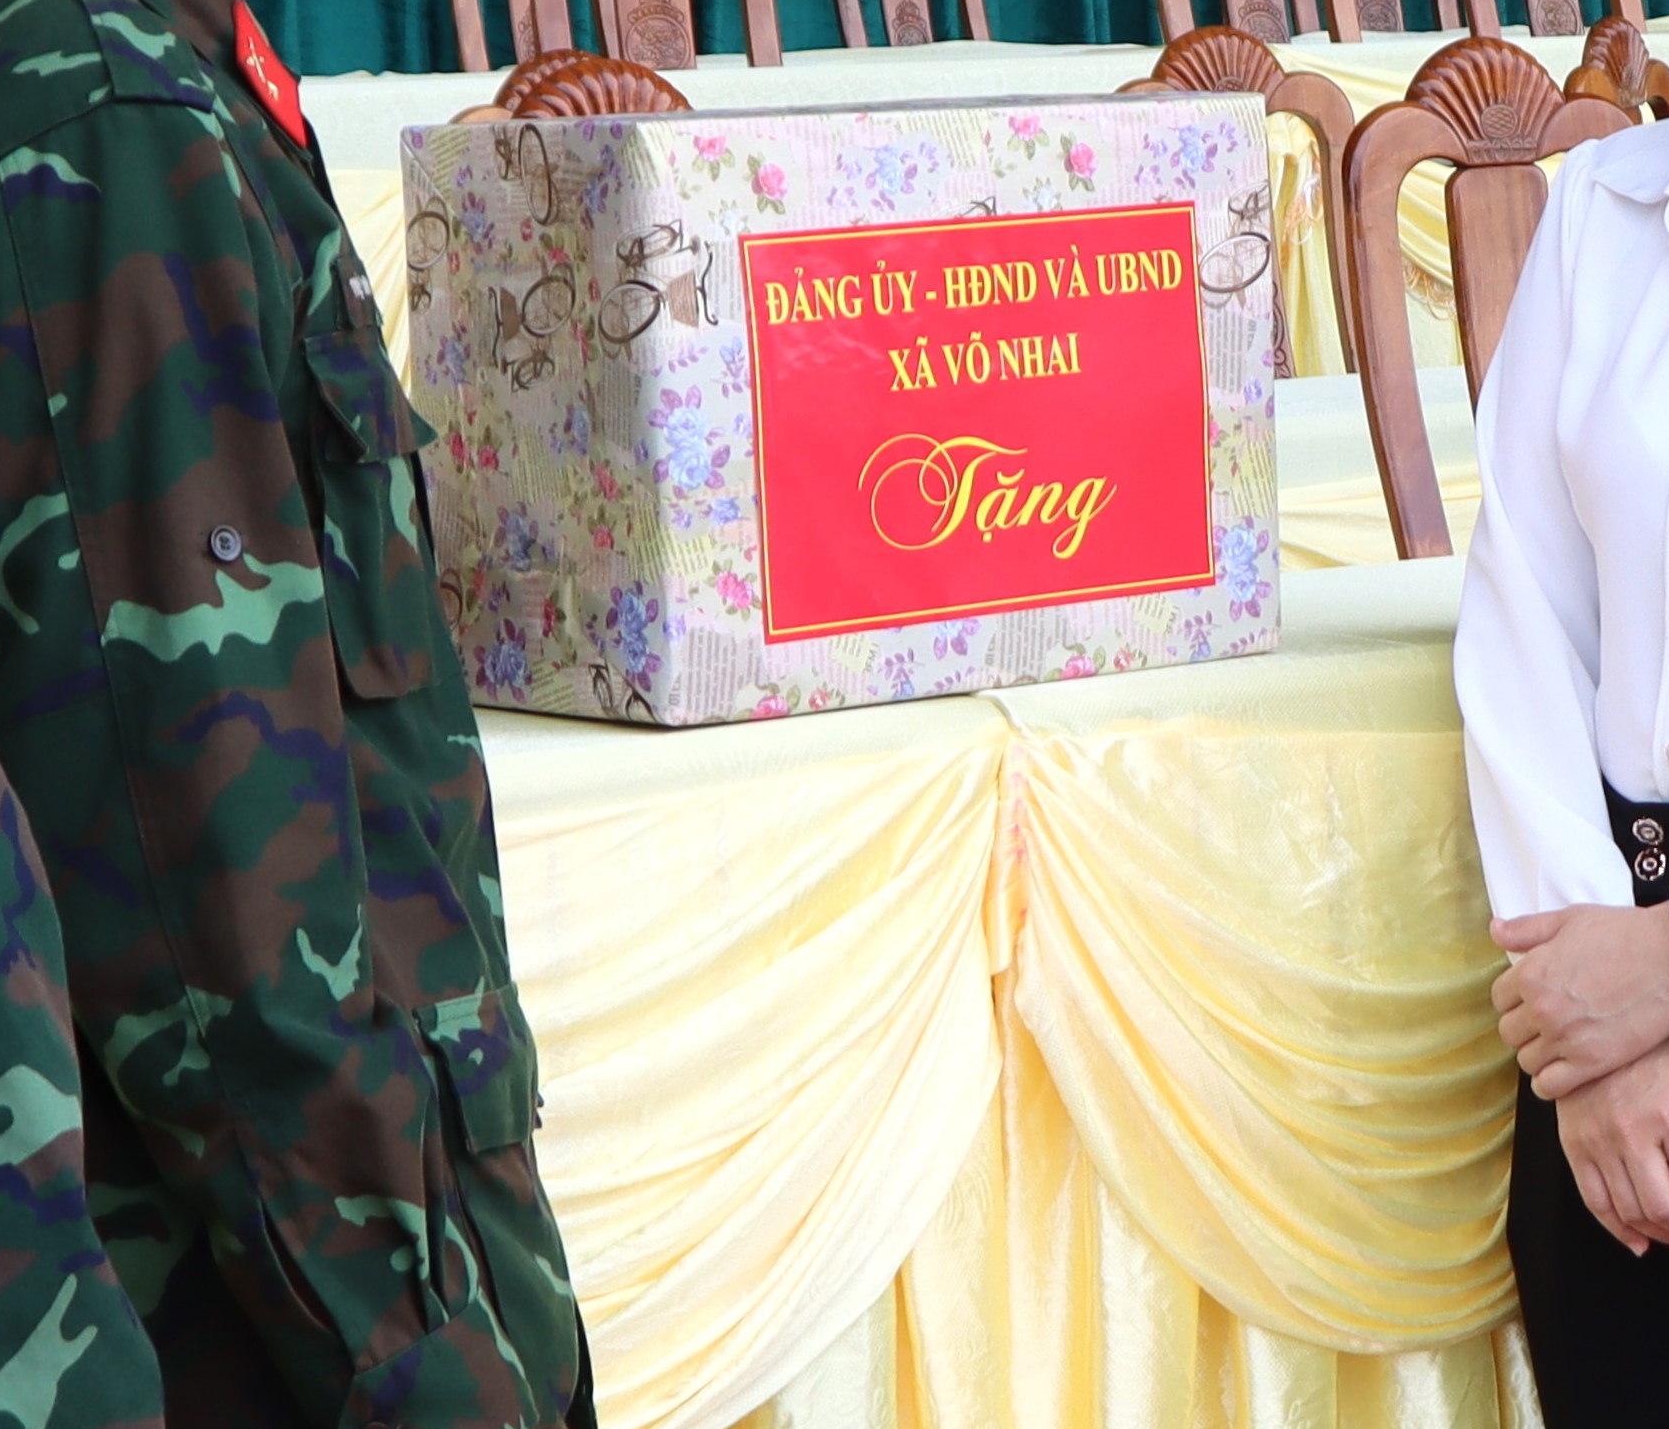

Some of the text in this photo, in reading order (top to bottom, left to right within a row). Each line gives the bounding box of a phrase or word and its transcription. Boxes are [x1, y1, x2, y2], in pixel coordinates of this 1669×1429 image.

[764, 268, 862, 325] ĐẢNG
[871, 260, 918, 316] ỦY
[943, 261, 1038, 309] HĐND
[1044, 245, 1090, 299] VÀ
[1095, 248, 1183, 295] UBND
[888, 332, 1082, 392] XÃ VÕ NHAI
[858, 433, 1118, 560] Tặng
